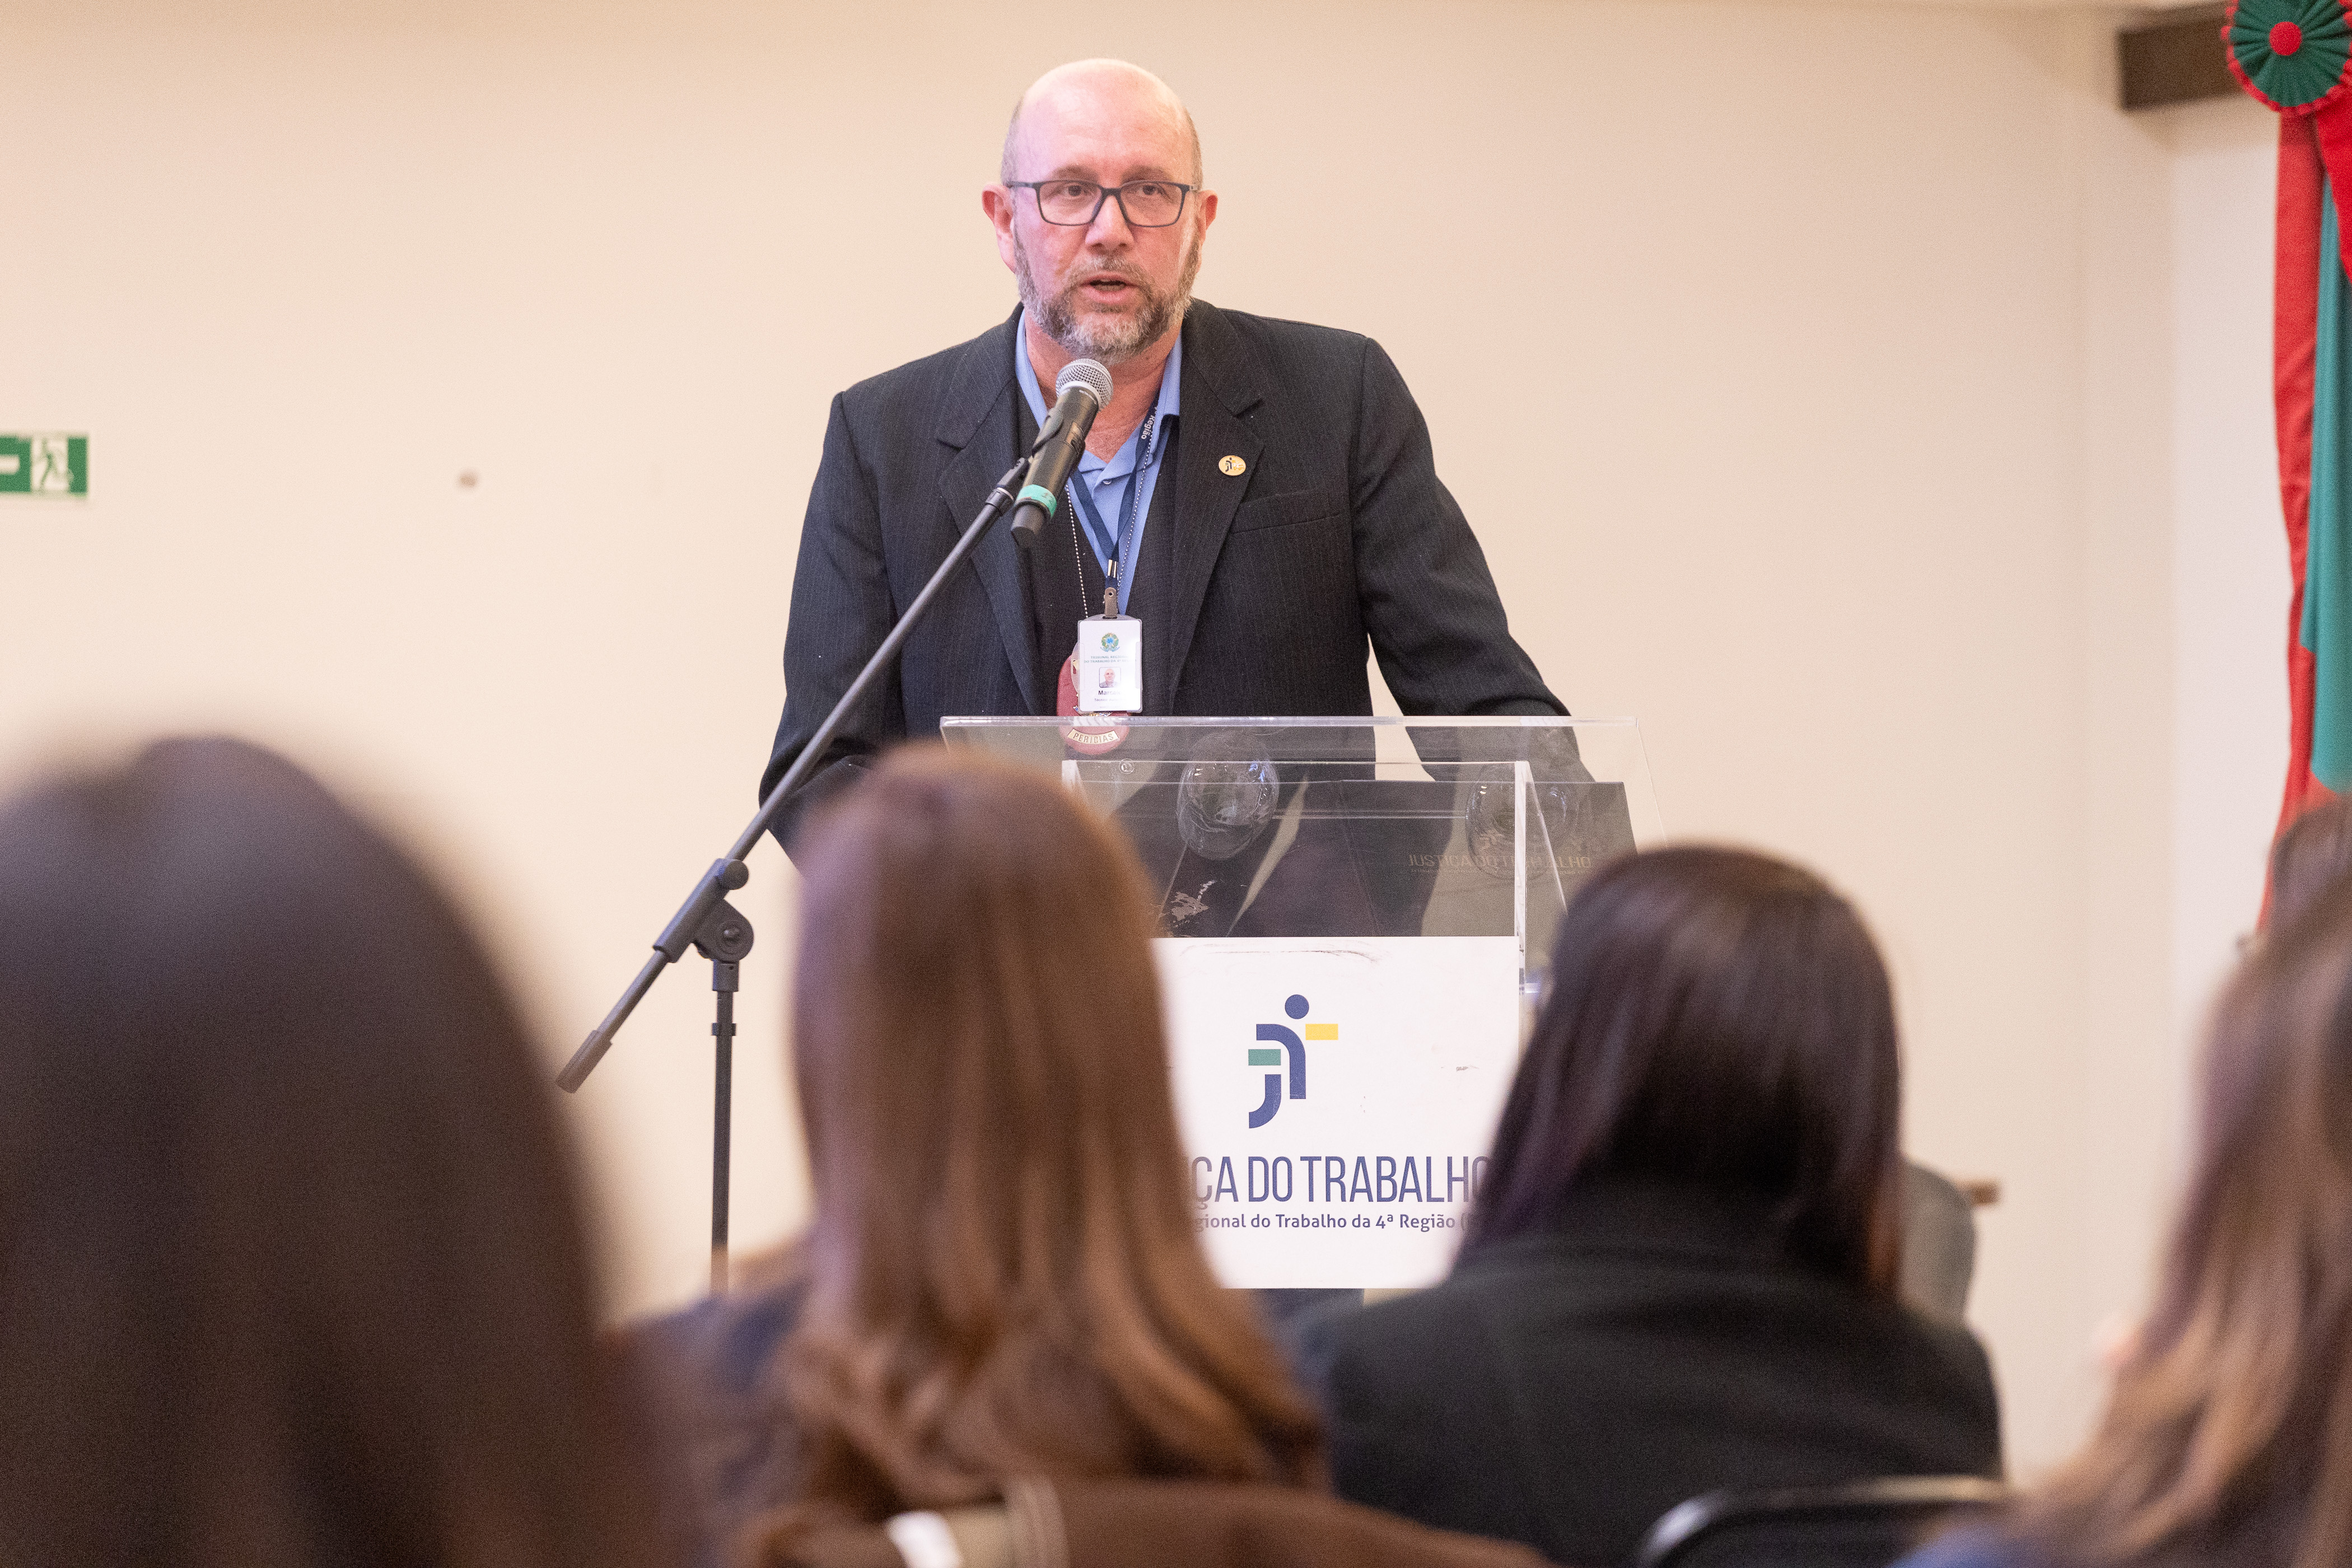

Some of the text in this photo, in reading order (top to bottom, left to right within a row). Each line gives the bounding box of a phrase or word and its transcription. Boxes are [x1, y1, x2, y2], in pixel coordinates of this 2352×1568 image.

[1141, 415, 1155, 440] Região
[1190, 1156, 1491, 1210] ÇA DO TRABALHO
[1194, 1214, 1246, 1233] gional
[1250, 1214, 1271, 1228] do
[1275, 1214, 1347, 1228] Trabalho
[1352, 1214, 1371, 1228] da
[1375, 1214, 1394, 1229] 4ª
[1400, 1214, 1455, 1233] Região
